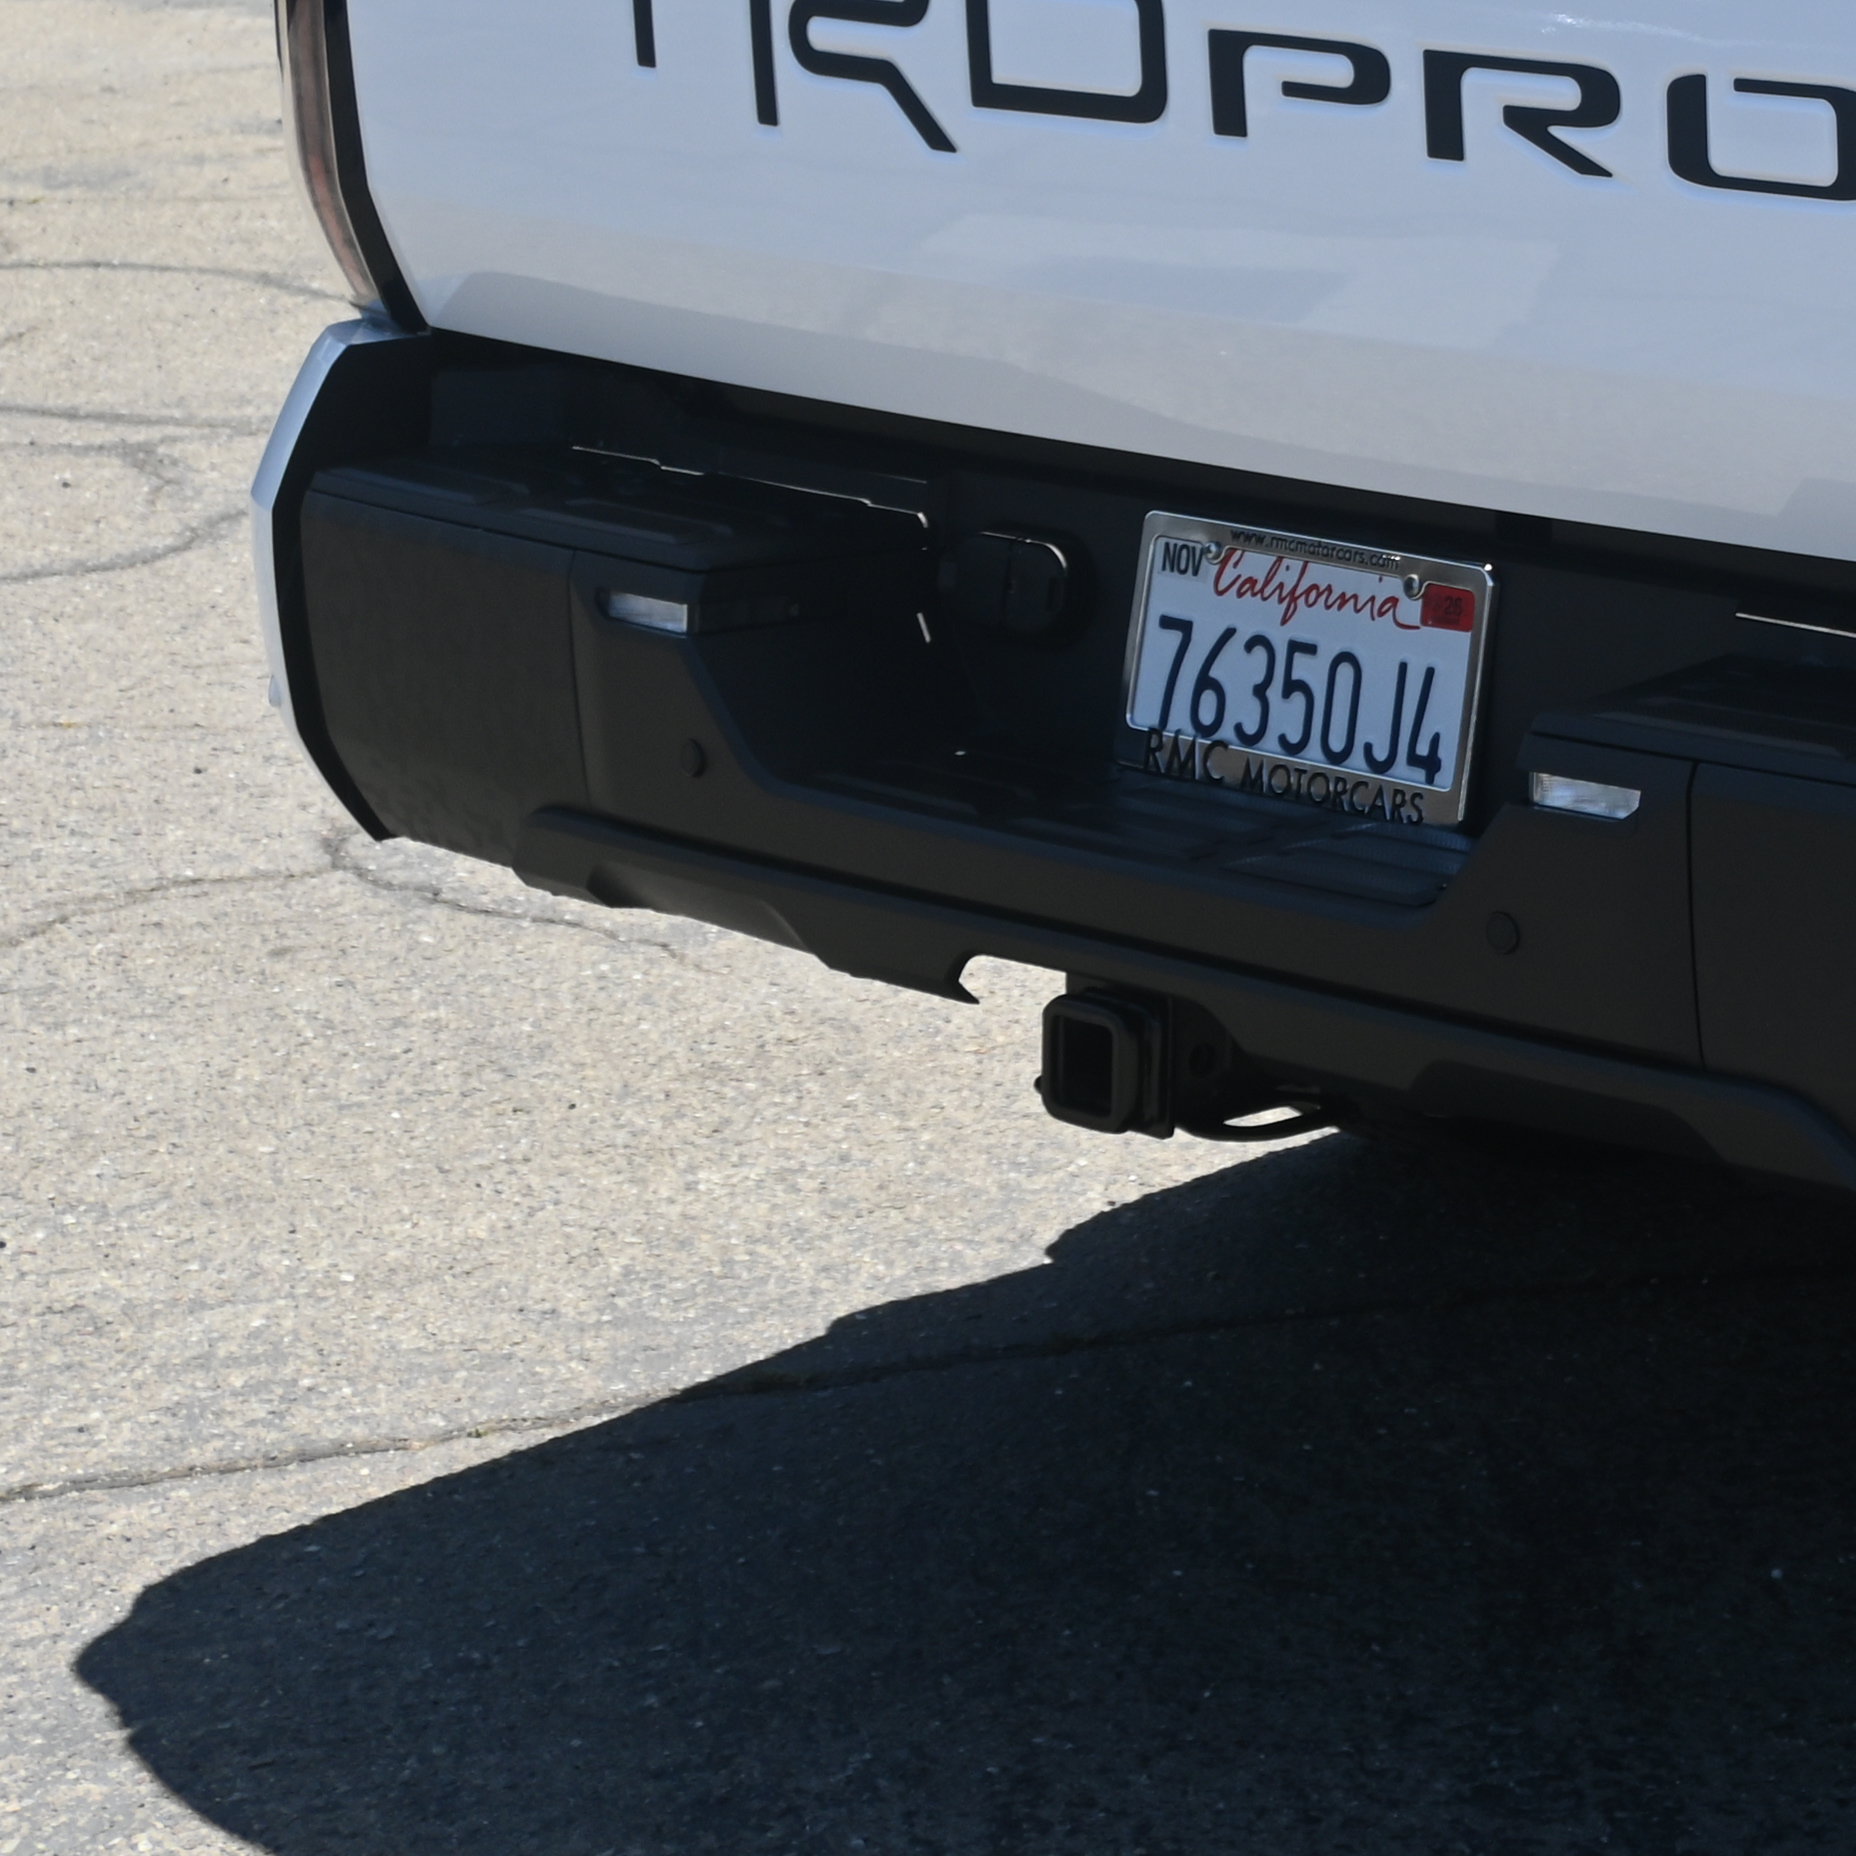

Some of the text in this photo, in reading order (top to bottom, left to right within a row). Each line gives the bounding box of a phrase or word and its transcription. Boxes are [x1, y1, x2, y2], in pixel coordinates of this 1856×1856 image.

[1160, 541, 1206, 578] NOV
[1212, 546, 1421, 630] California
[1157, 614, 1443, 785] 76350J4
[1143, 727, 1425, 826] RMC MOTORCARS
